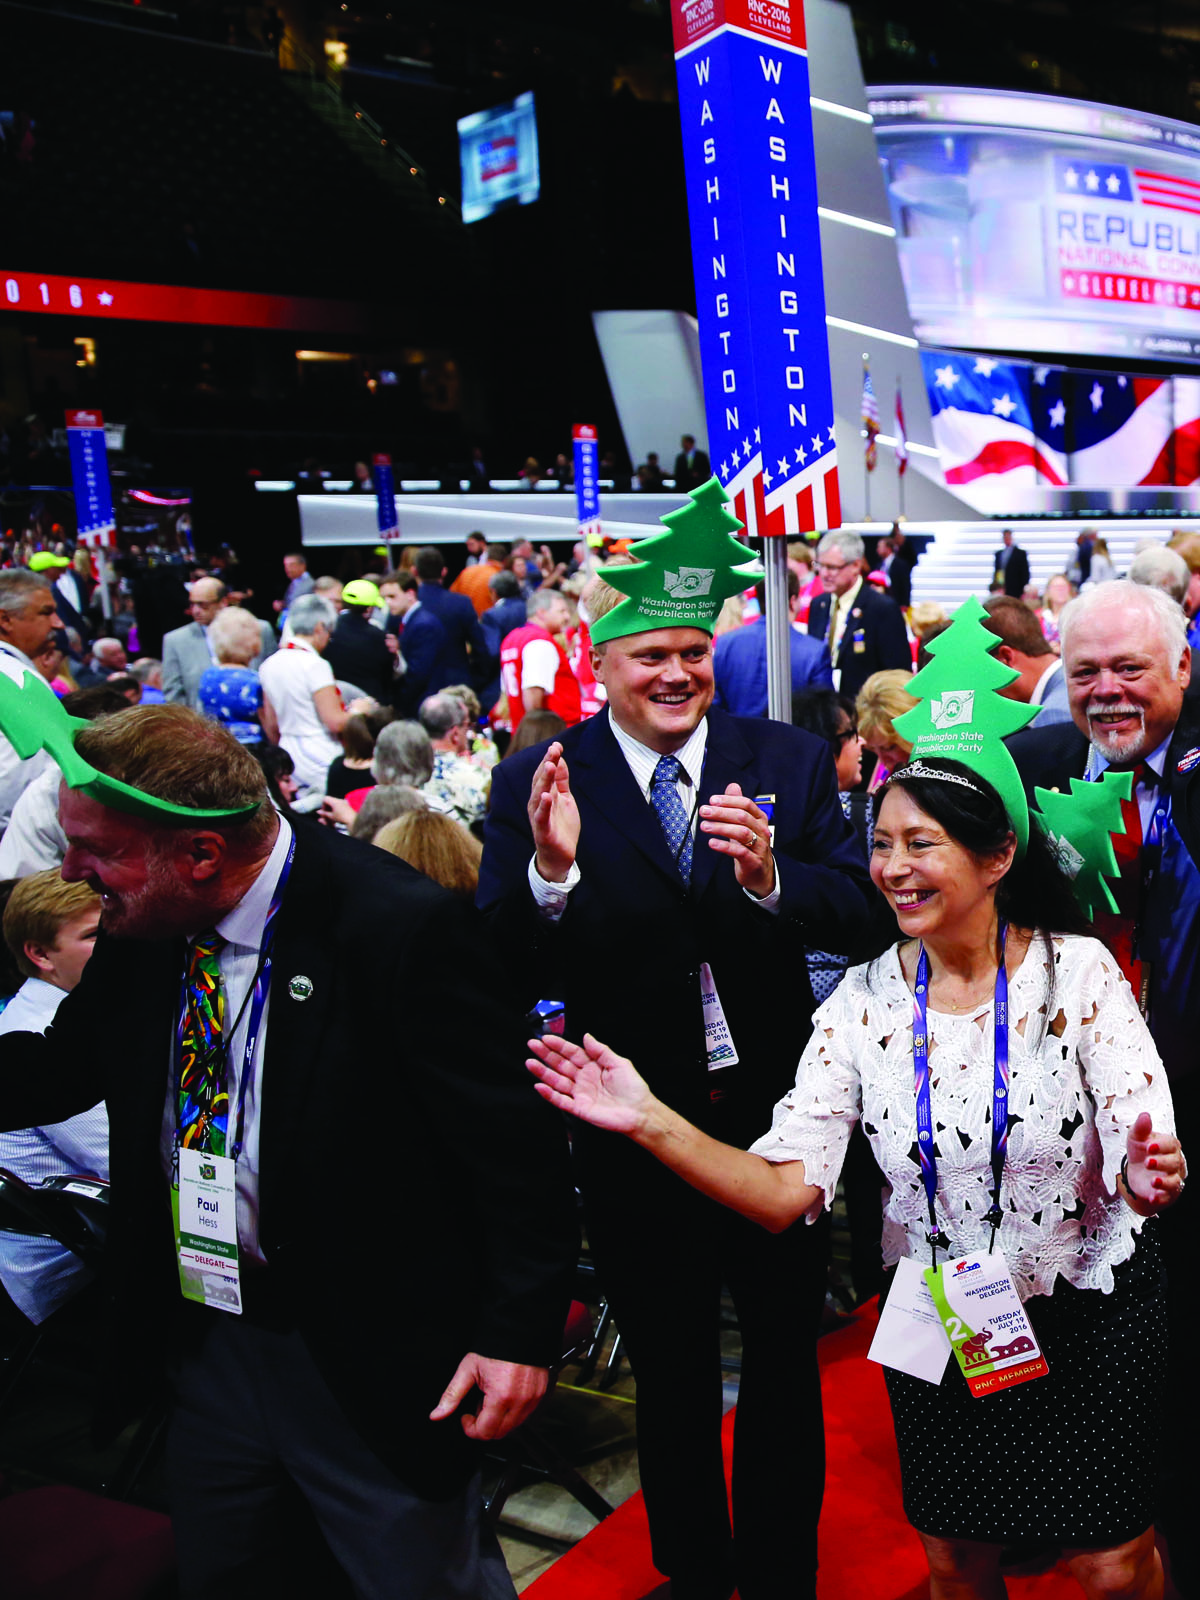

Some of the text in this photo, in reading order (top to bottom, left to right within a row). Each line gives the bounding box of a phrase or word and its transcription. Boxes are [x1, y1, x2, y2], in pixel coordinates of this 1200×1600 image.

[687, 12, 715, 34] CLEVELAND
[748, 12, 791, 34] CLEVELAND
[694, 56, 739, 430] WASHINGTON
[759, 55, 807, 427] WASHINGTON
[1058, 247, 1151, 270] NATIONAL
[5, 278, 83, 308] 016
[641, 596, 716, 610] Washington State
[637, 605, 714, 619] Republican Party
[917, 731, 984, 743] Washington State
[957, 742, 983, 754] Party
[705, 1020, 724, 1030] ESDAY
[713, 1033, 728, 1041] 2016
[197, 1197, 219, 1213] Paul
[198, 1215, 218, 1229] Hess
[189, 1239, 229, 1253] Washington State
[194, 1255, 225, 1269] DELEGATE
[964, 1278, 1010, 1297] WASHINGTON
[979, 1284, 1012, 1300] DELEGATE
[988, 1309, 1022, 1325] TUESDAY
[997, 1316, 1025, 1331] JULY 19
[945, 1316, 967, 1341] 2
[1010, 1323, 1027, 1334] 2016
[974, 1378, 996, 1392] RNC
[998, 1362, 1043, 1383] MEMBER
